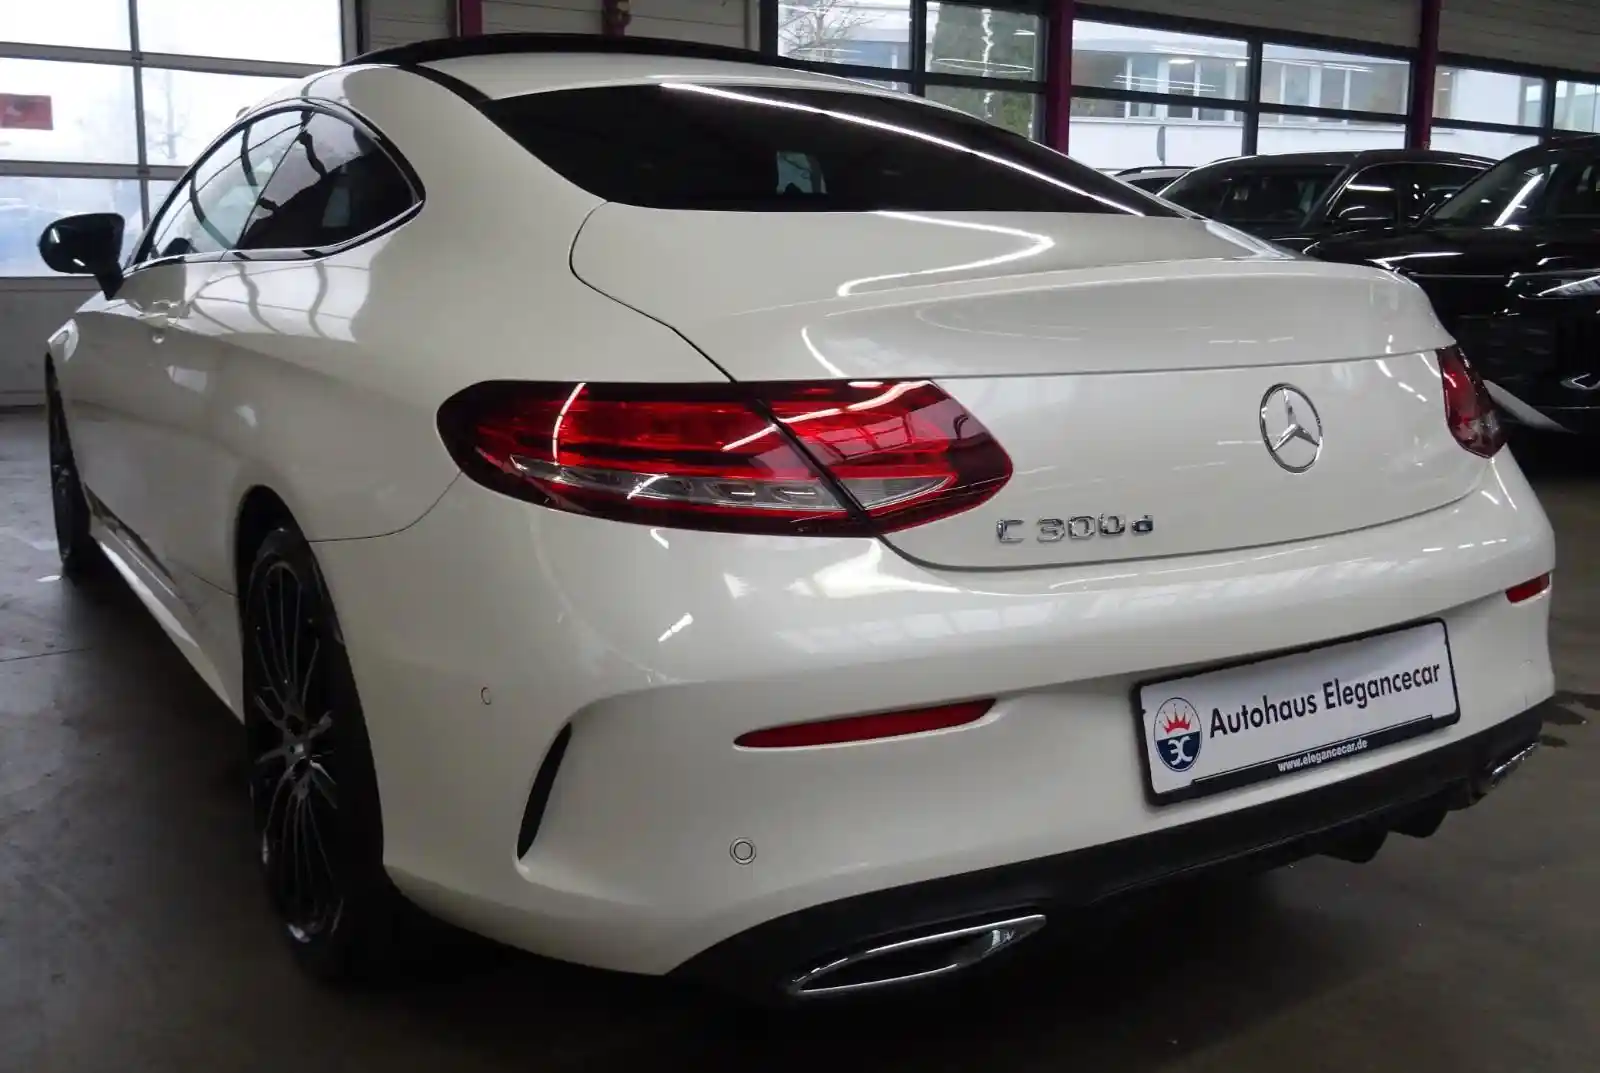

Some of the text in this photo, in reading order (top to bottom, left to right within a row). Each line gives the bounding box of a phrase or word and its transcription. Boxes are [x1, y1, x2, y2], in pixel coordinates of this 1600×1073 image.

[996, 519, 1024, 543] C
[1209, 663, 1440, 738] Autohaus Elegancecar
[1277, 738, 1368, 772] www.elegancecar.de
